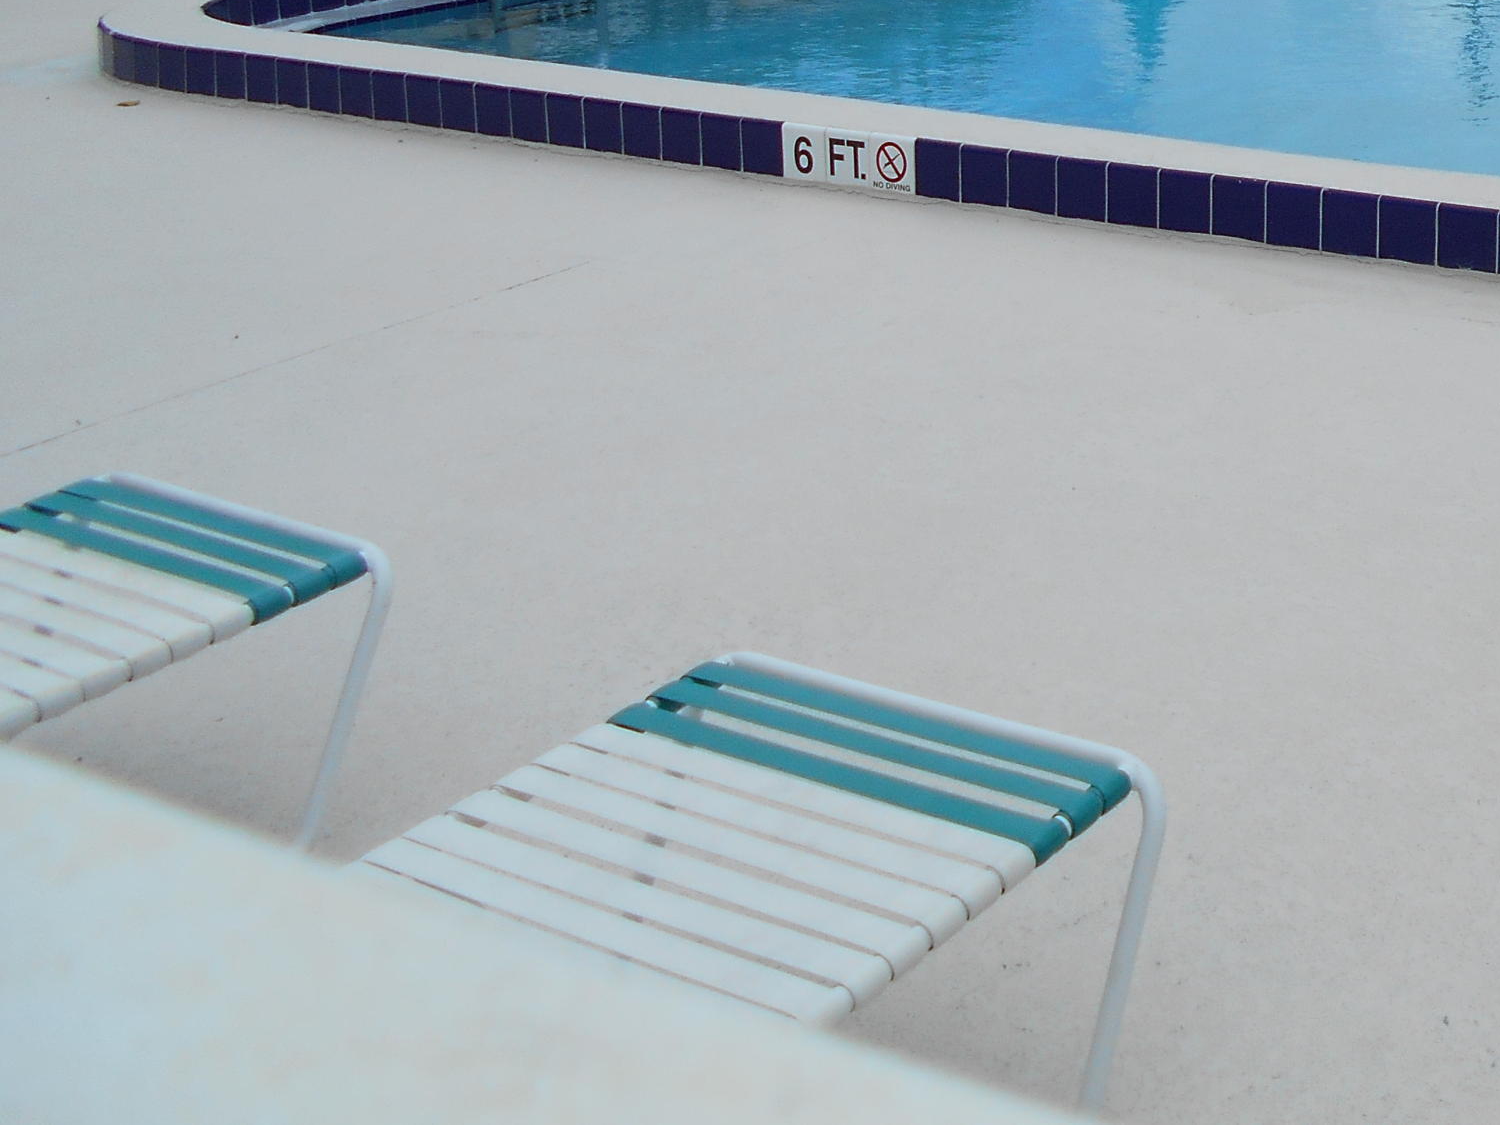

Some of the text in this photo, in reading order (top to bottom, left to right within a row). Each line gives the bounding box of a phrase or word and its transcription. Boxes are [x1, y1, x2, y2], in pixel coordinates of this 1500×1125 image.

[794, 136, 867, 180] 6 FT.
[872, 181, 911, 192] NO DIVING
